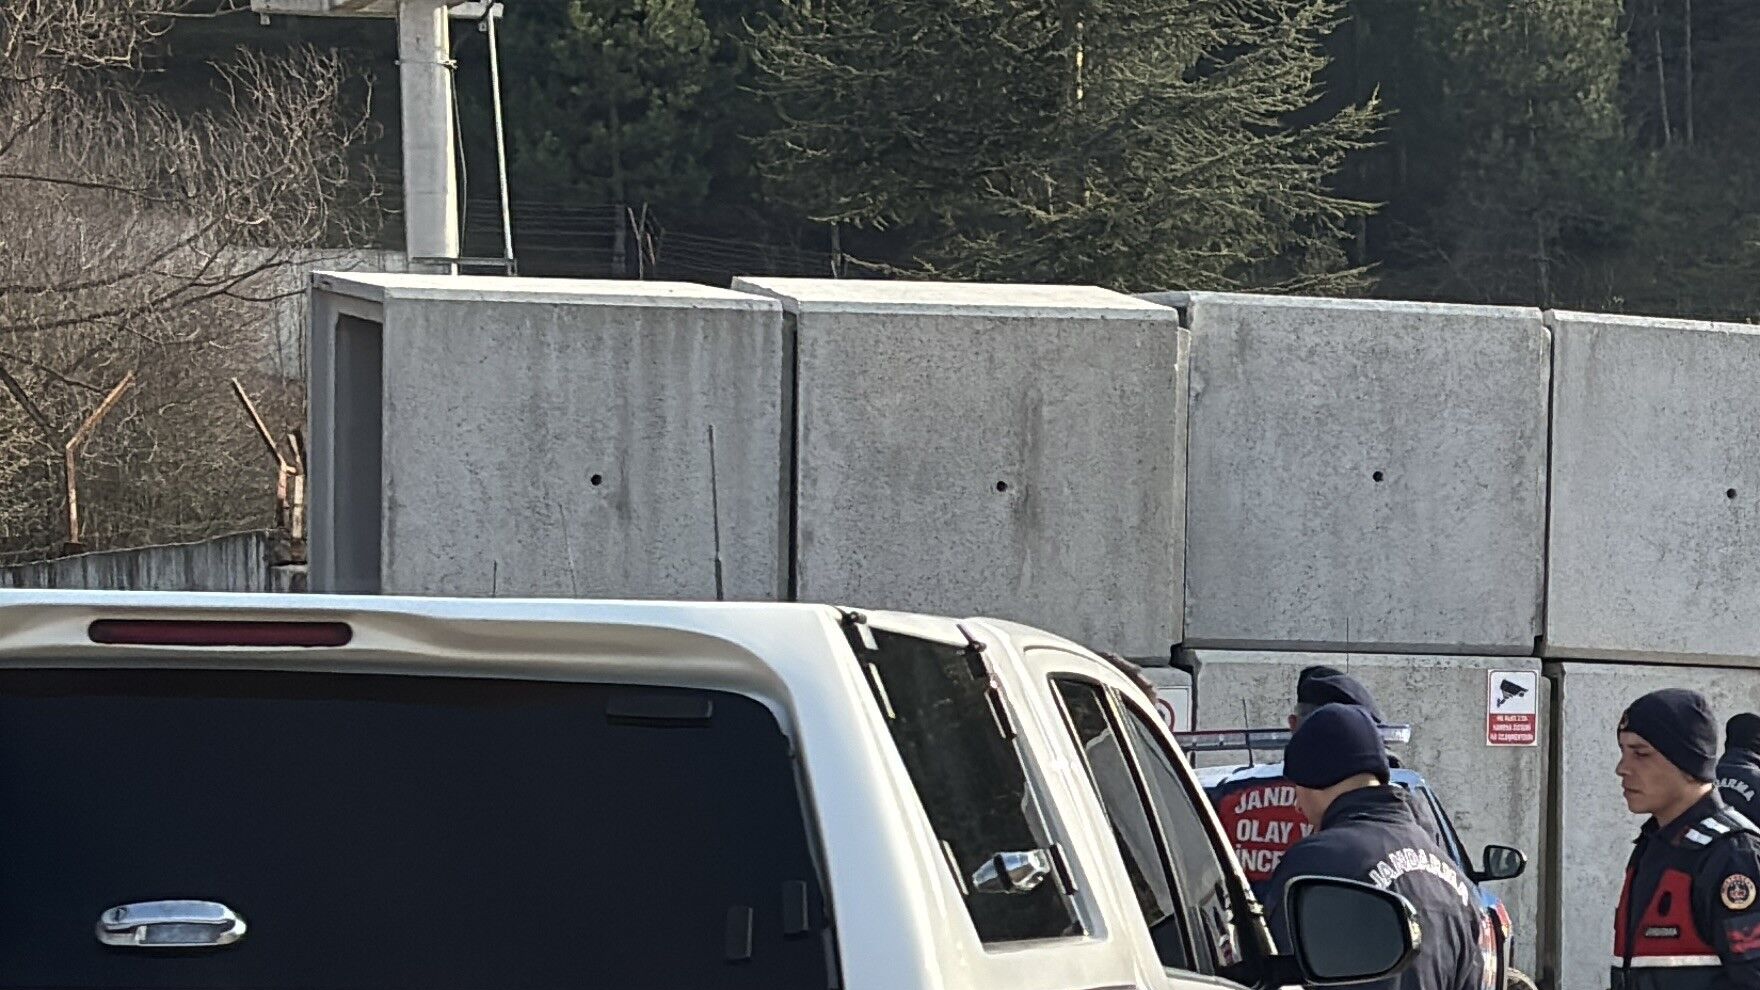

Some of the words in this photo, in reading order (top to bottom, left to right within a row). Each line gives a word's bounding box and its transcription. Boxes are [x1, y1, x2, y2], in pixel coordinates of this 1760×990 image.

[1235, 786, 1298, 815] JAND
[1236, 818, 1294, 845] OLAY
[1368, 847, 1469, 906] JANDARMA
